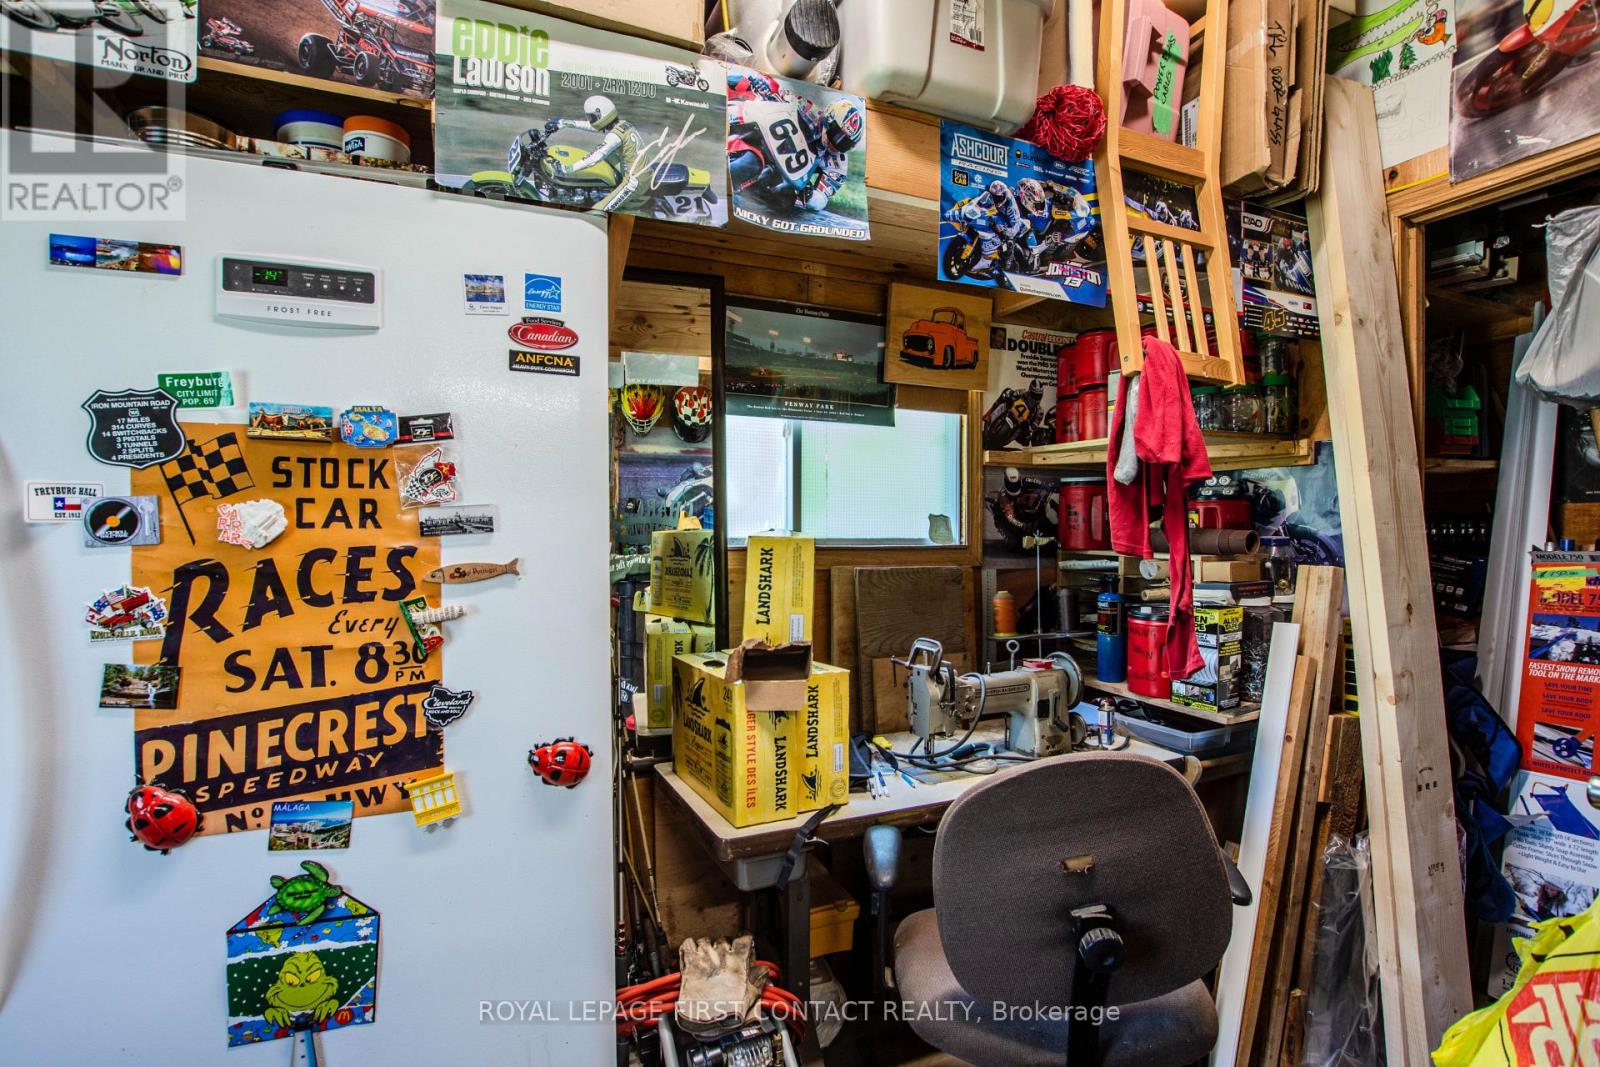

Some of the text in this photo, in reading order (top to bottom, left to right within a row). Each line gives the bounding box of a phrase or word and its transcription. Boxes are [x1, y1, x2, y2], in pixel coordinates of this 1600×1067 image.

[97, 34, 192, 73] Norton
[134, 65, 164, 76] GRAND
[453, 56, 550, 98] Lawson
[951, 132, 1010, 167] ASHCOURT
[735, 206, 866, 240] NICKY GOT GROUNDED
[266, 304, 333, 318] FROST FREE
[517, 325, 573, 344] Canadian
[165, 375, 226, 391] Freyburg
[176, 388, 218, 398] CITY LIMIT
[182, 397, 215, 406] POP. 69
[91, 402, 110, 410] IRON
[111, 400, 149, 409] MOUNTAIN
[150, 399, 171, 407] ROAD
[815, 403, 835, 411] PARK
[112, 427, 168, 437] SWITCHBACKS
[126, 422, 157, 430] CURVES
[123, 441, 158, 449] TUNNELS
[118, 452, 165, 461] PRESIDENTS
[271, 456, 390, 489] STOCK
[34, 486, 98, 497] FREYBURG HALL
[296, 497, 383, 530] CAR
[756, 546, 774, 626] LANDSHARK
[158, 545, 418, 667] RACES
[327, 609, 399, 640] Every
[224, 644, 337, 693] SAT.
[1528, 661, 1557, 673] FASTEST
[1556, 664, 1578, 675] SNOW
[1528, 668, 1547, 678] TOOL
[1548, 671, 1560, 679] ON
[1560, 672, 1576, 681] THE
[423, 695, 472, 709] Cleveland
[683, 712, 713, 746] LANDSHARK
[805, 684, 820, 759] LANDSHARK
[140, 690, 434, 790] PINECREST
[745, 735, 757, 766] STYLE
[196, 751, 385, 803] SPEEDWAY
[746, 767, 757, 786] DES
[773, 735, 788, 812] LANDSHARK
[273, 802, 311, 813] MÁLAGA
